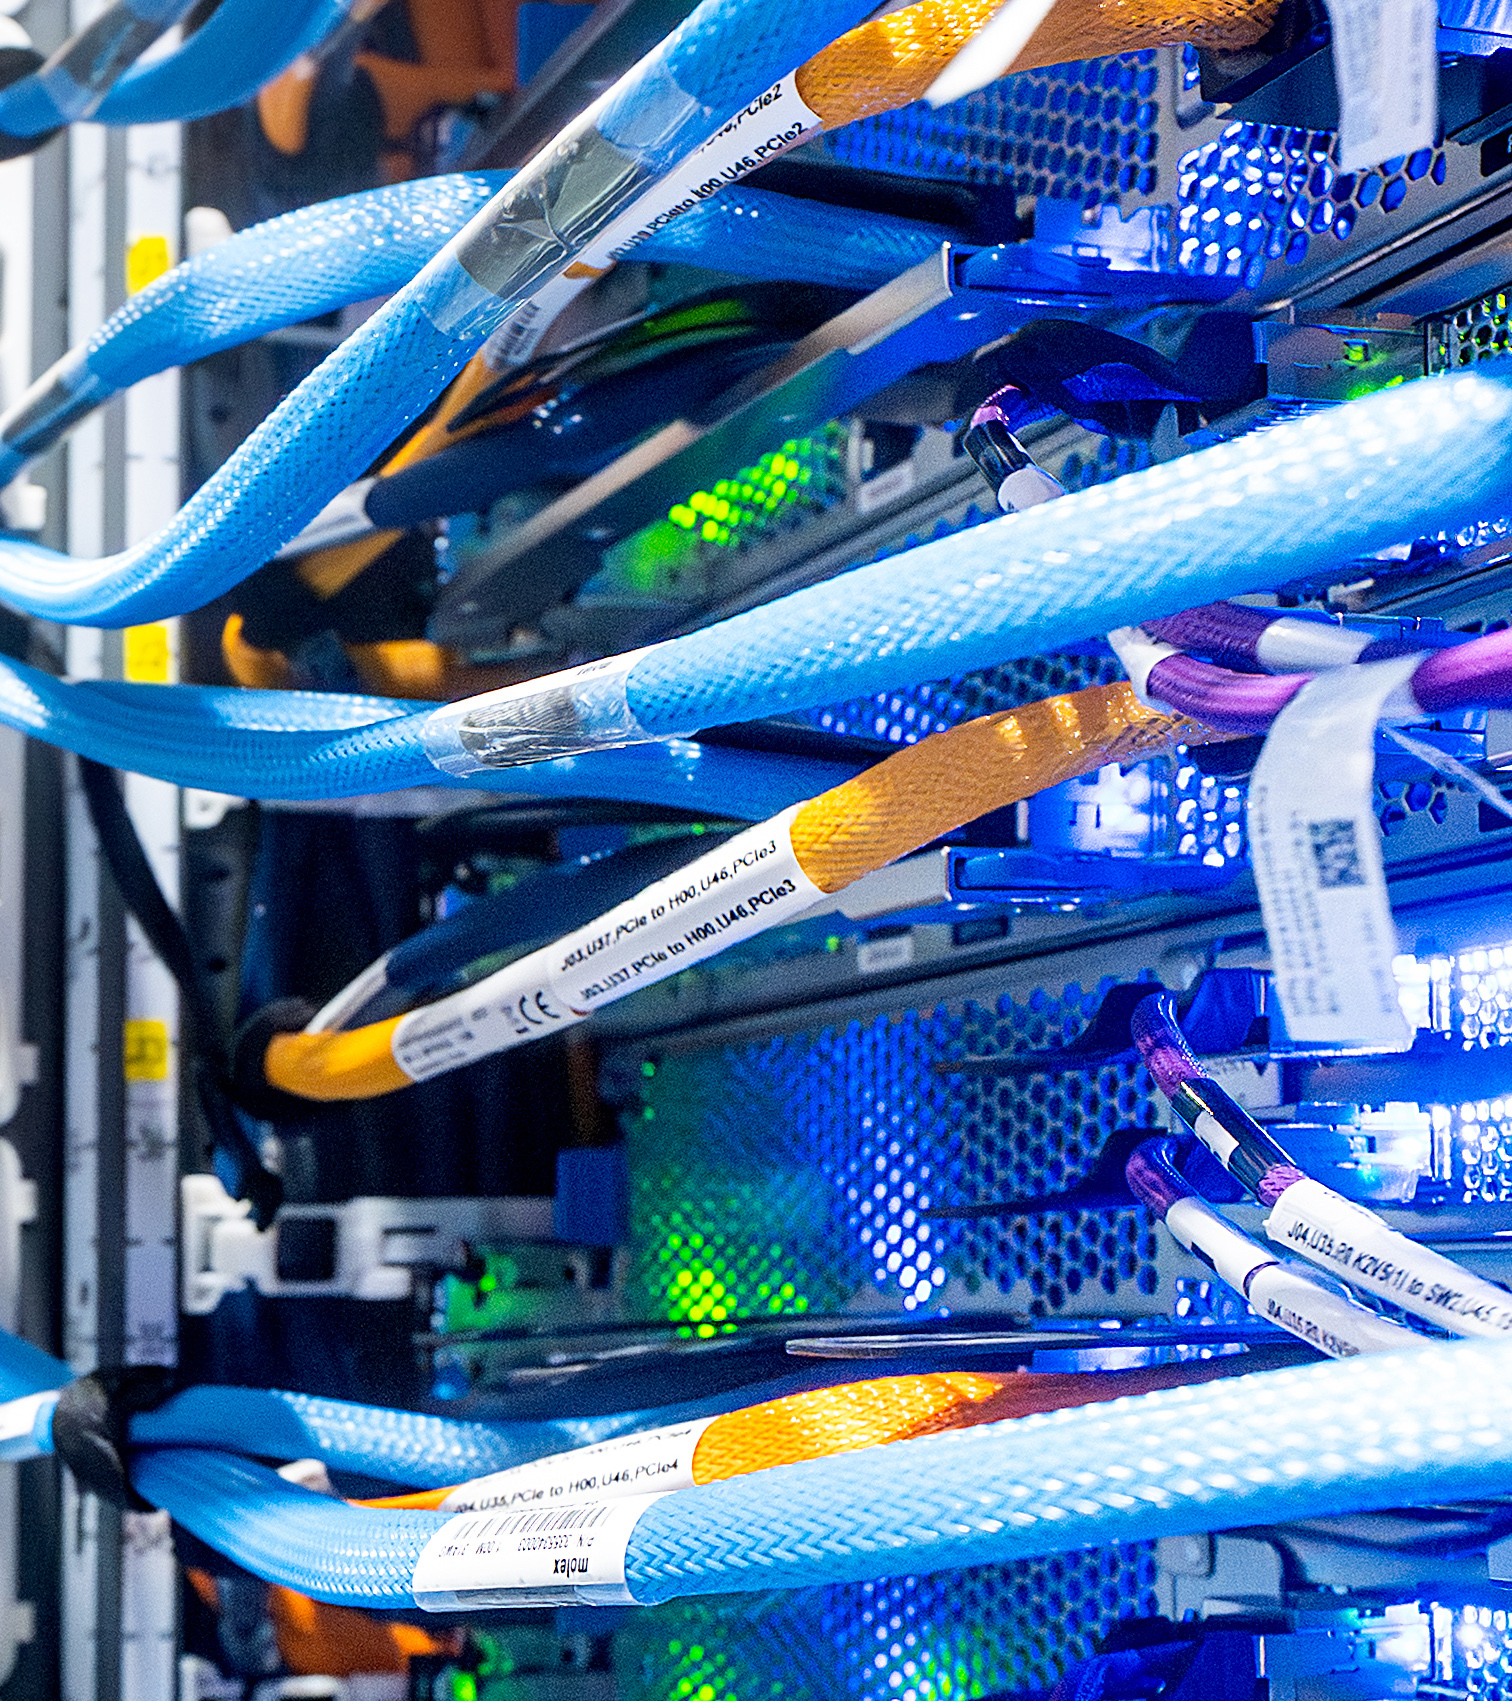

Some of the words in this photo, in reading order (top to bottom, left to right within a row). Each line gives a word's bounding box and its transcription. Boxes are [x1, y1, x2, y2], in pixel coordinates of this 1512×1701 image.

[648, 903, 667, 921] to
[665, 838, 779, 912] H00,U46,PCIe3
[665, 936, 686, 957] to
[685, 876, 797, 949] H00,U46,PCIe3
[548, 1482, 564, 1499] to
[567, 1456, 680, 1496] H00,U46,PCIe4
[549, 1557, 590, 1576] molex
